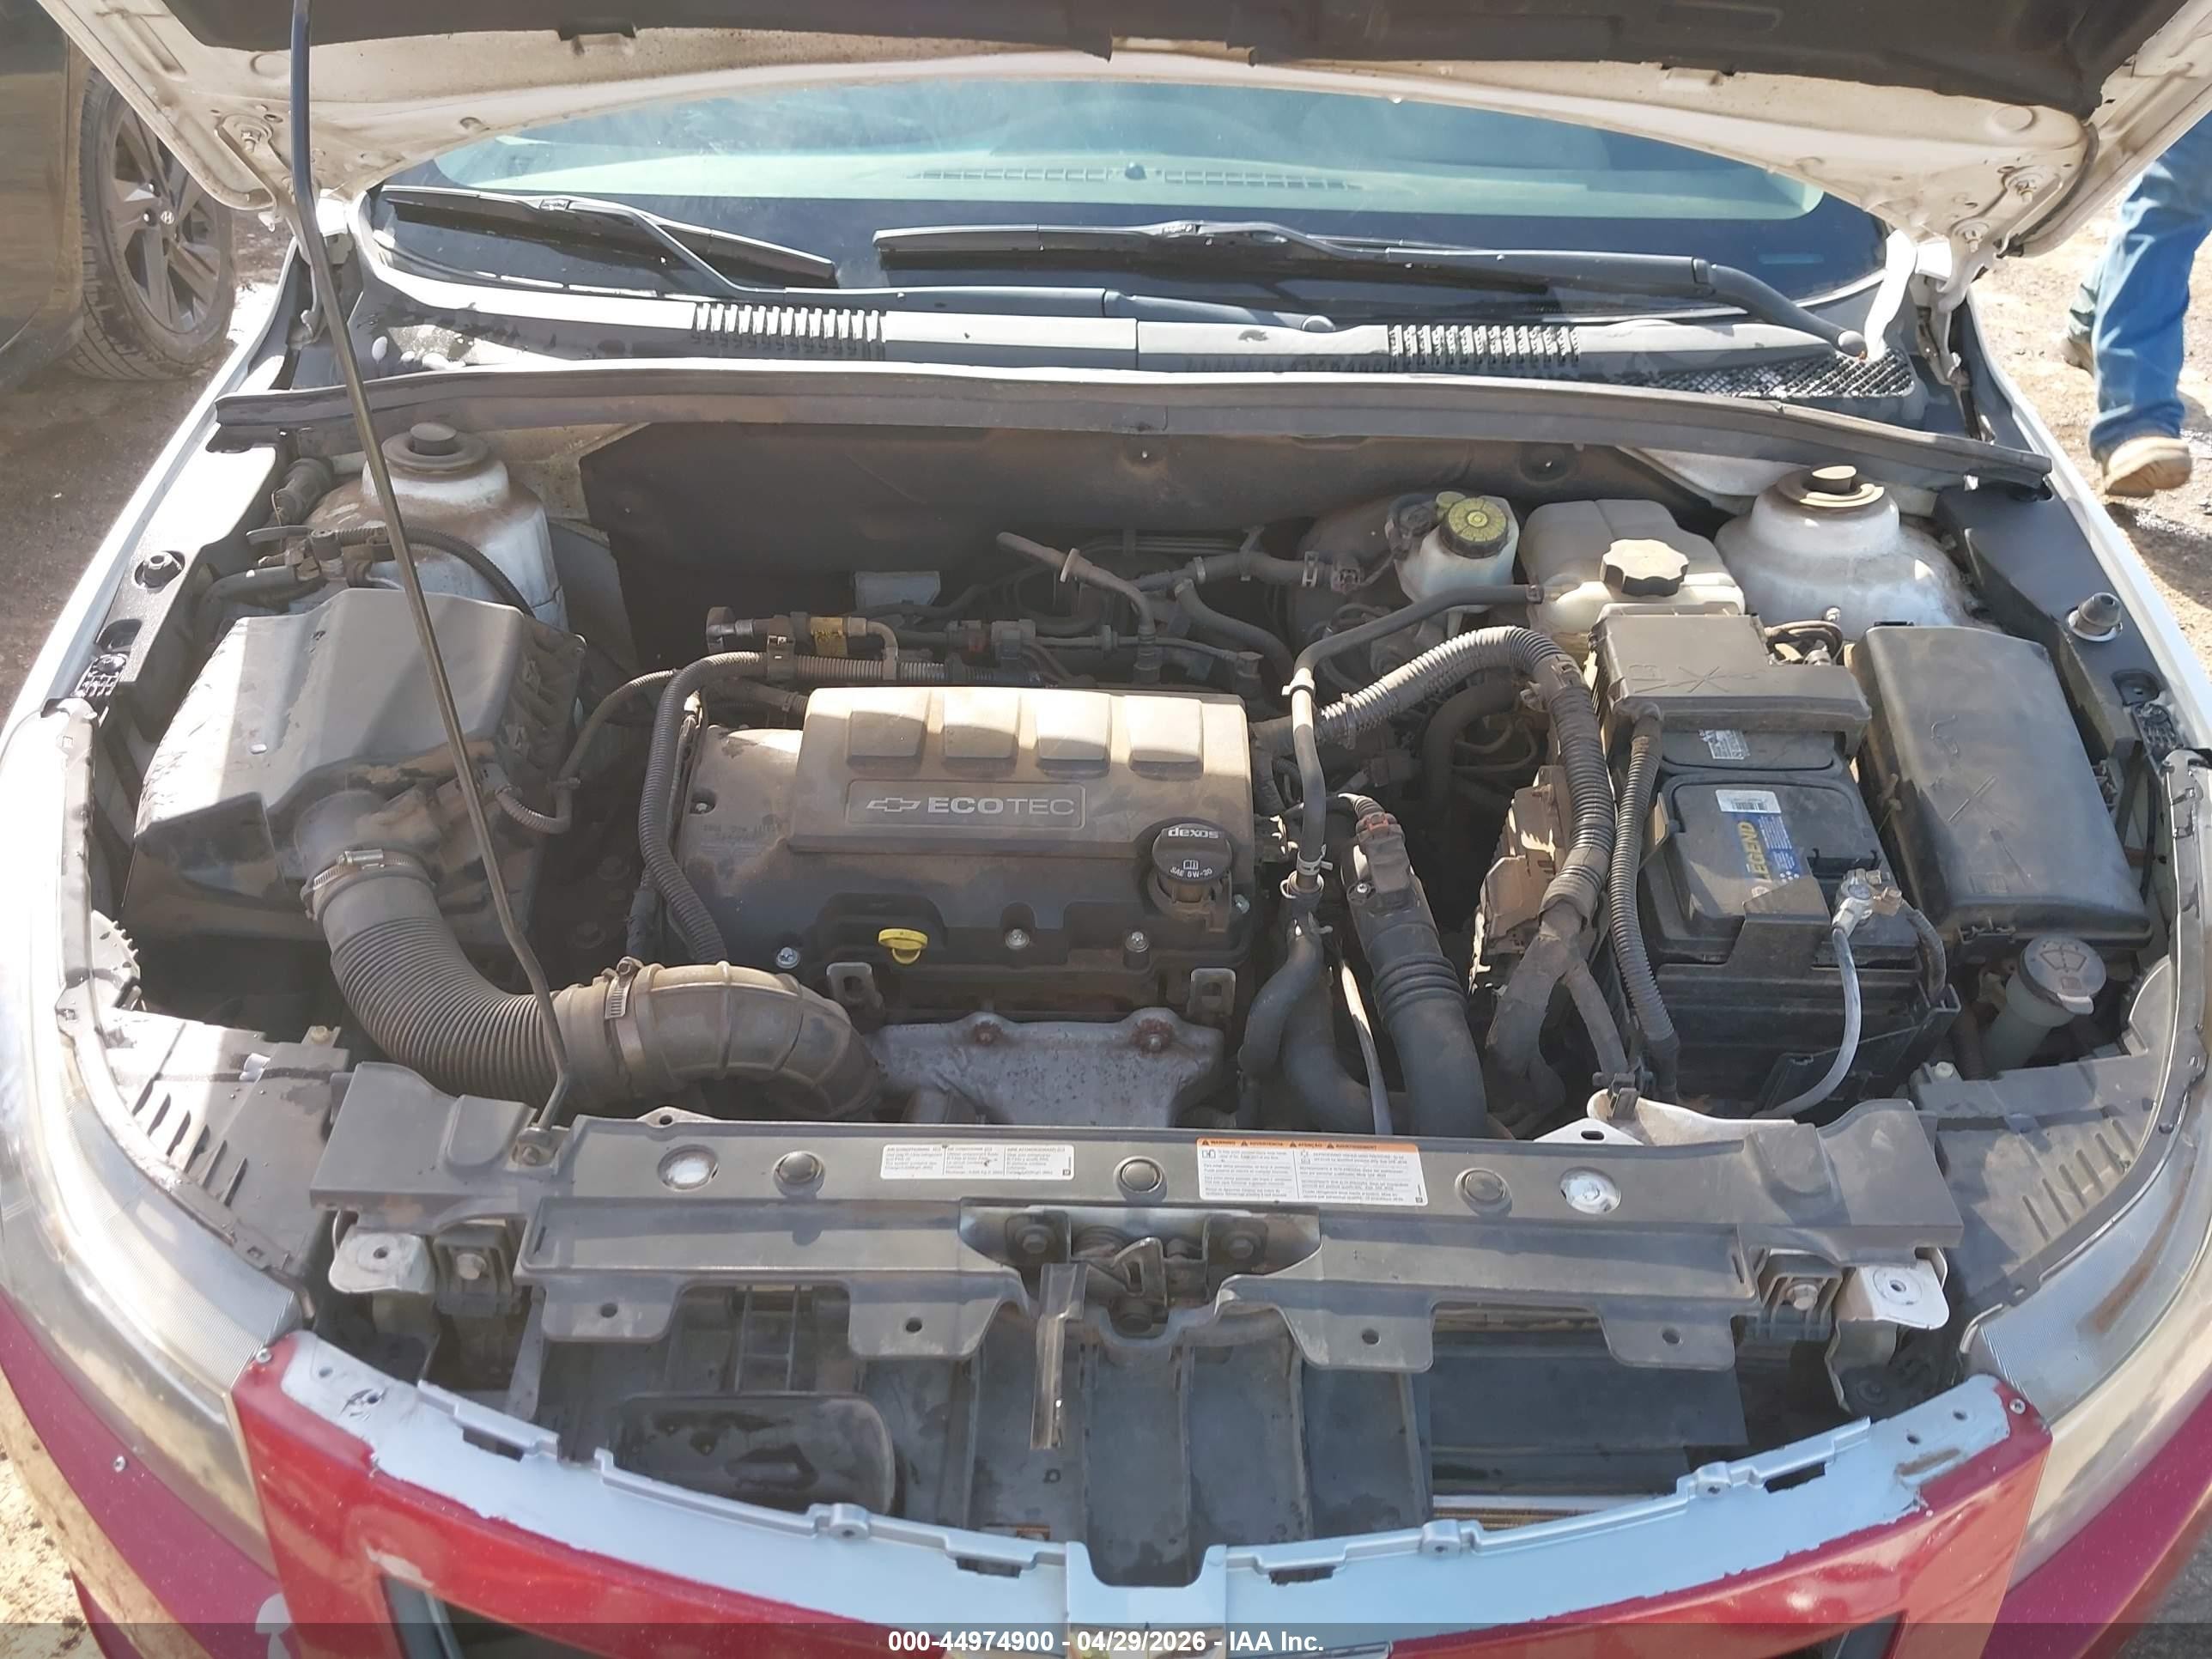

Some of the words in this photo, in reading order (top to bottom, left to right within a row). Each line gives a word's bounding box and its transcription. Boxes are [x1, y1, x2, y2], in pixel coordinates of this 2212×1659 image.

[927, 796, 1075, 816] ECOTEC
[1168, 827, 1219, 839] dexos
[1170, 866, 1185, 878] SAE
